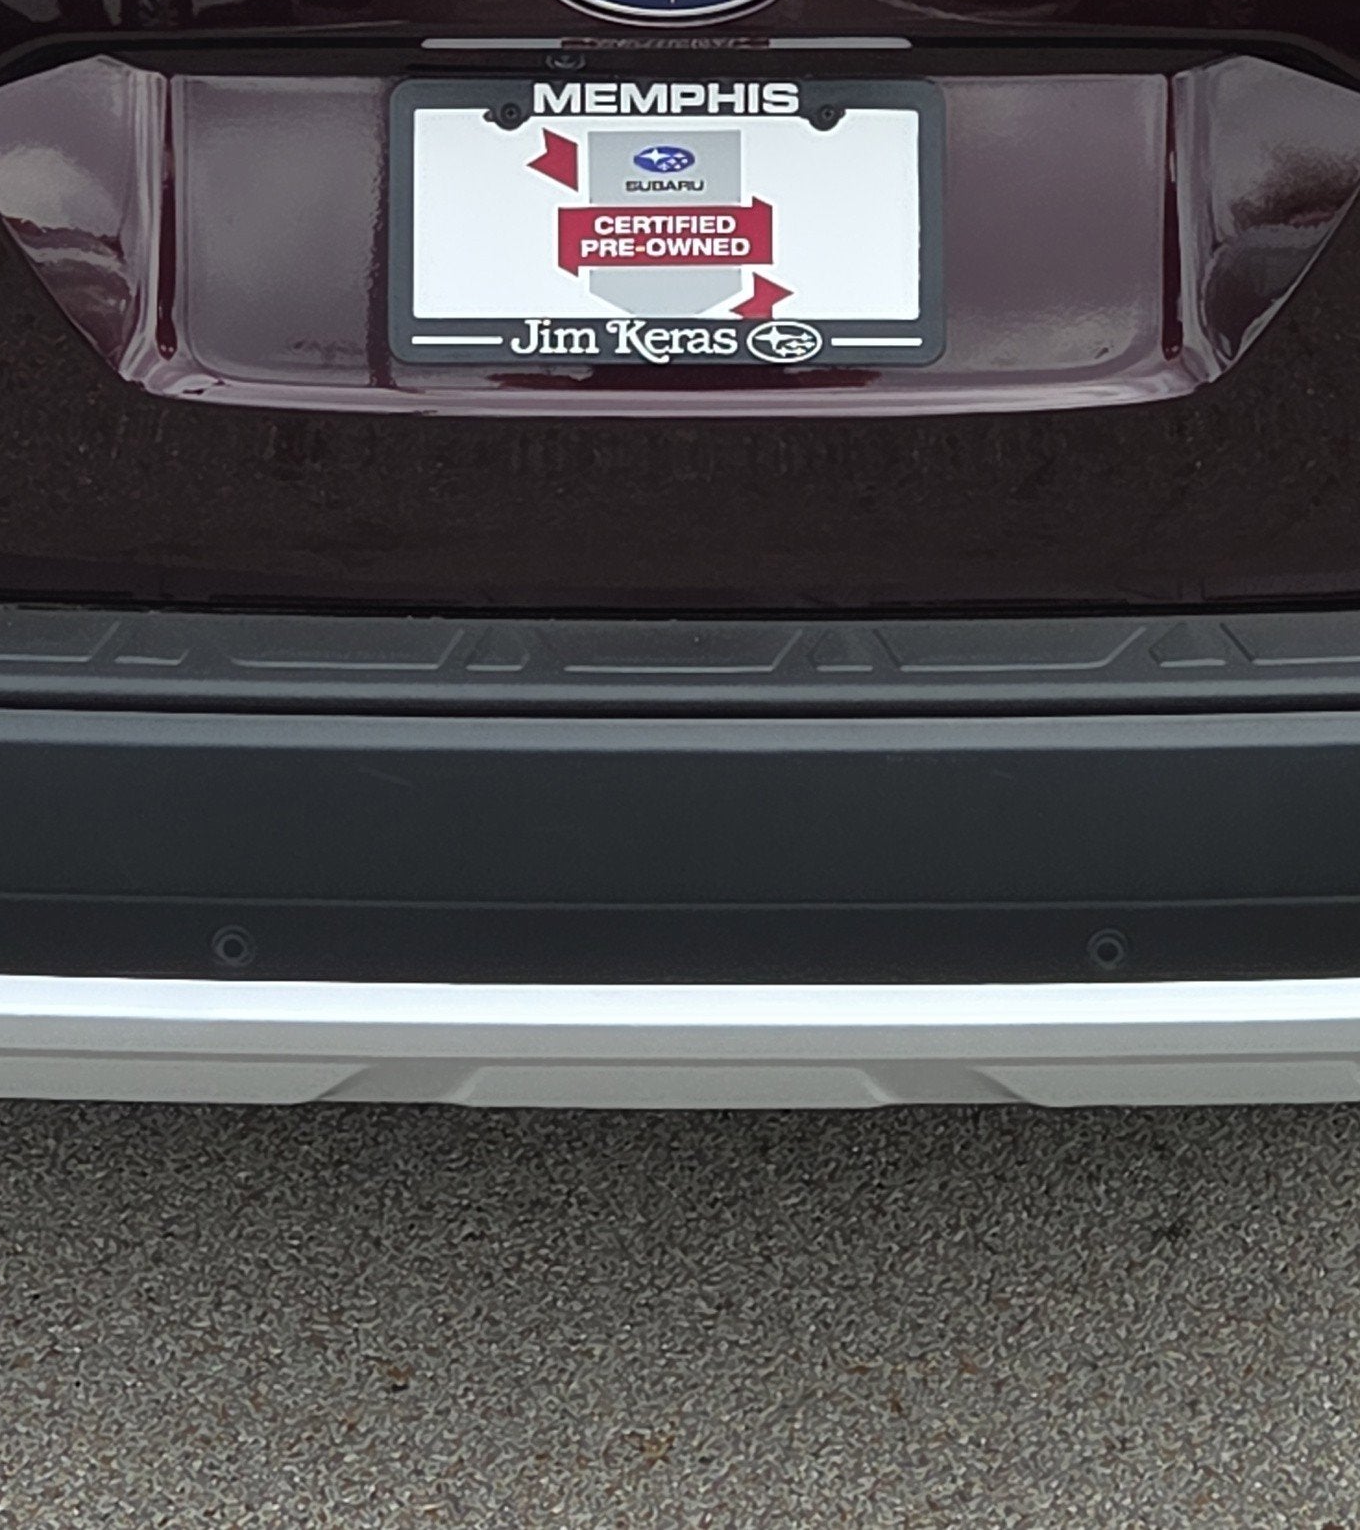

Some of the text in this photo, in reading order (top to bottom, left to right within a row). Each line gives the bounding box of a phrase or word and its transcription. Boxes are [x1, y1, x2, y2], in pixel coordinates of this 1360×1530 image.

[533, 82, 800, 114] MEMPHIS
[625, 180, 705, 192] SUBARU
[593, 215, 737, 235] CERTIFIED
[580, 237, 751, 258] PRE-OWNED
[510, 318, 738, 364] Jim Keras
